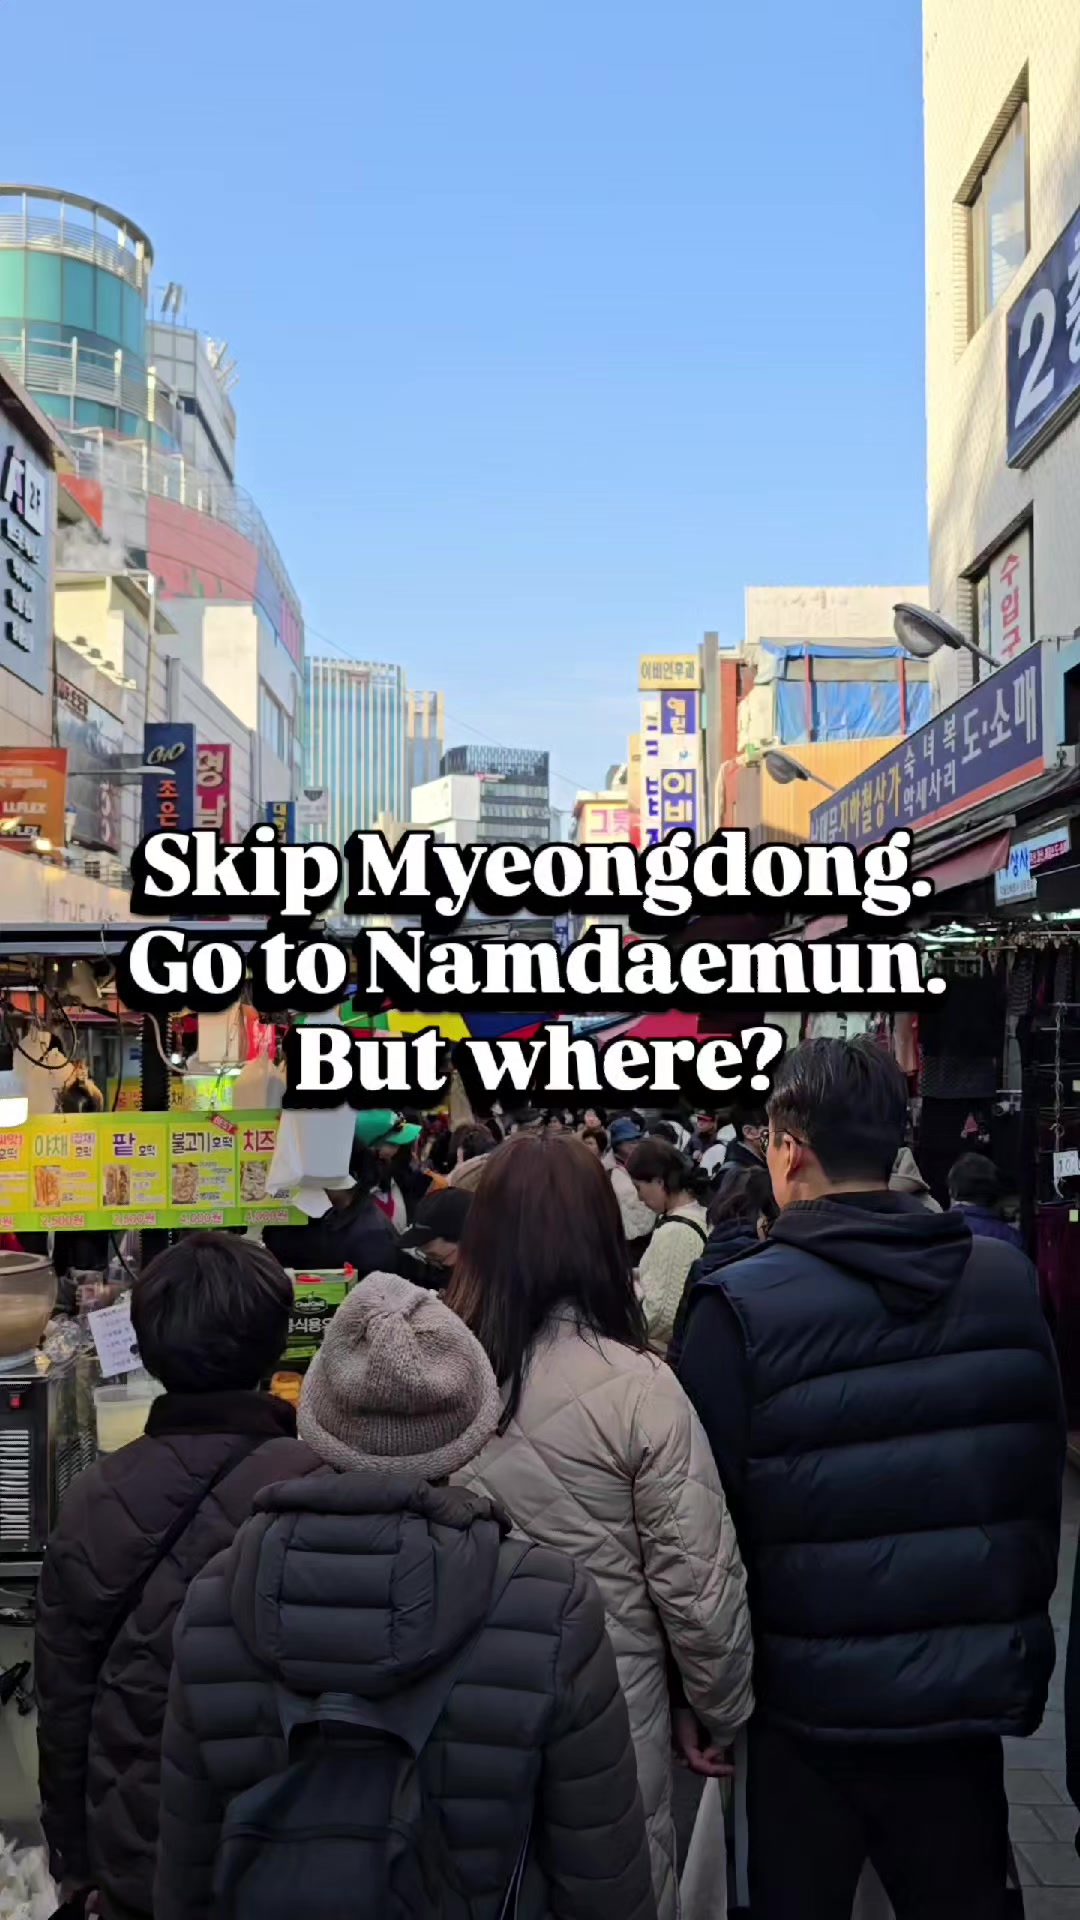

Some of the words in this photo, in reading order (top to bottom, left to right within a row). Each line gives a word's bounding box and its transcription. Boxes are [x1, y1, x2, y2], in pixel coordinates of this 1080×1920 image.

[903, 759, 956, 818] 악세사리
[662, 772, 695, 838] 이비
[35, 1134, 69, 1158] 야채
[113, 1133, 136, 1156] 팥
[172, 1132, 210, 1154] 불고기
[243, 1130, 275, 1151] 치즈
